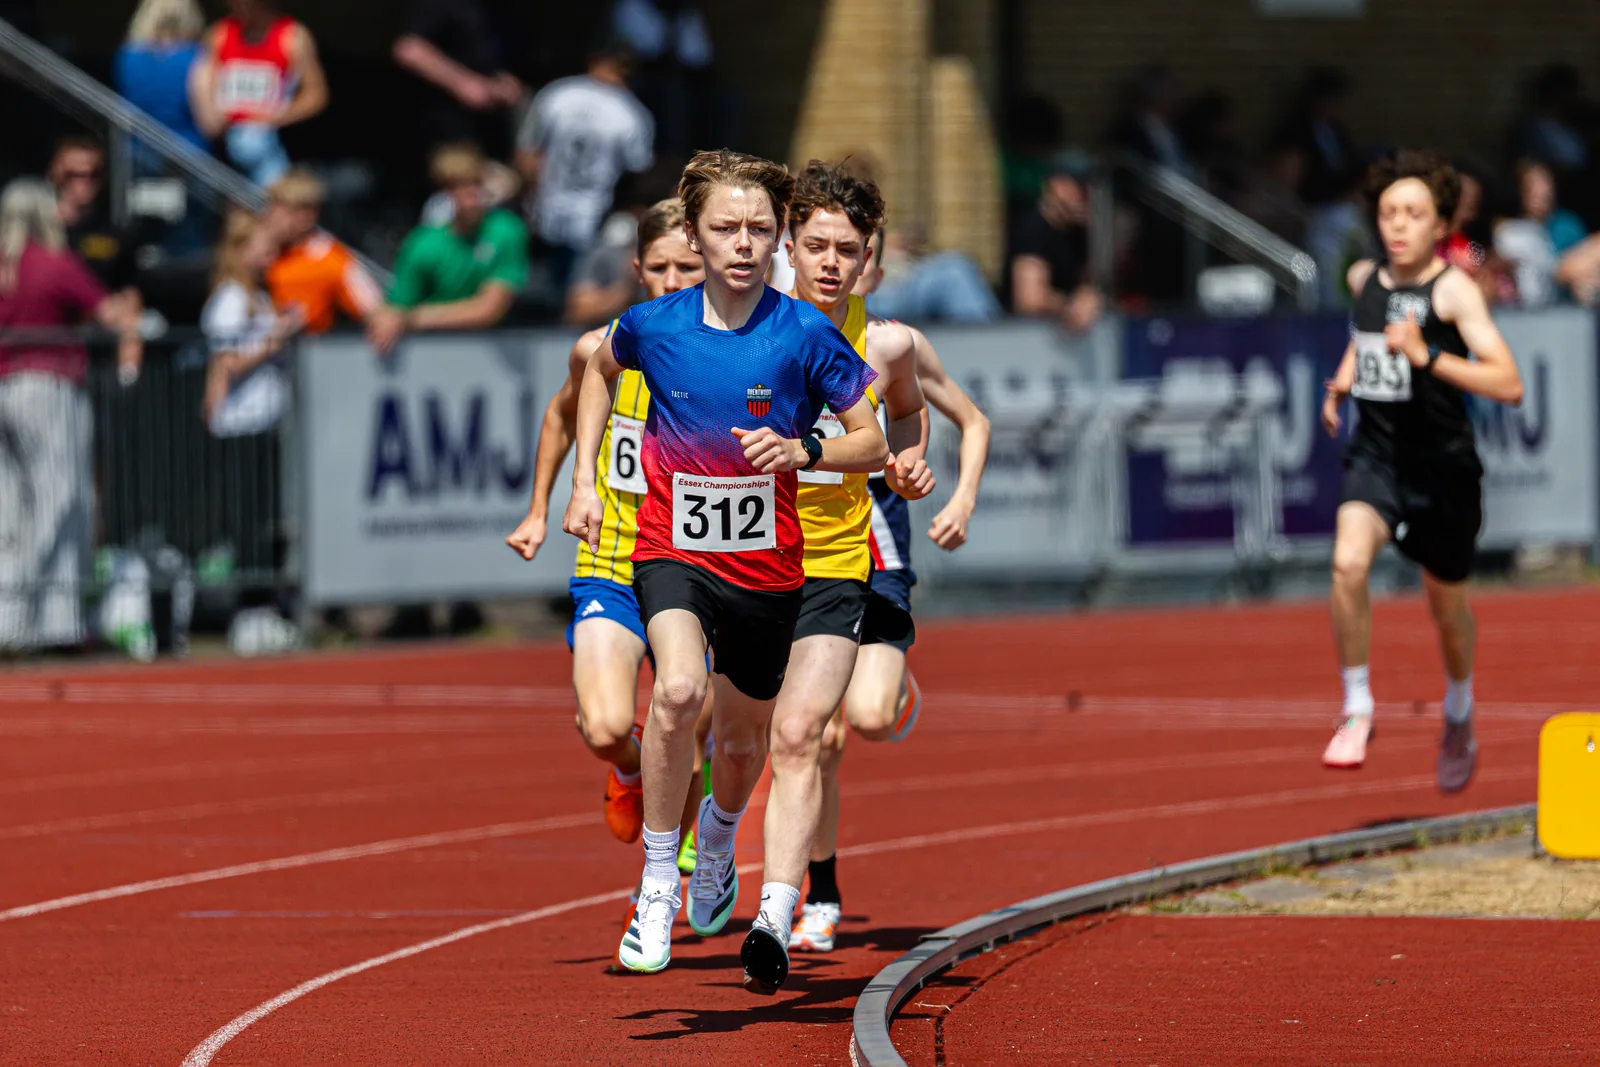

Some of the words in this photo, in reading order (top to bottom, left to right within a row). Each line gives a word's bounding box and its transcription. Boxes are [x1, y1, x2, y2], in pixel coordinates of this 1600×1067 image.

[671, 390, 688, 399] TACTIC
[366, 386, 533, 502] AMJ
[678, 478, 702, 488] Essex
[703, 479, 770, 491] Championships
[683, 494, 765, 541] 312
